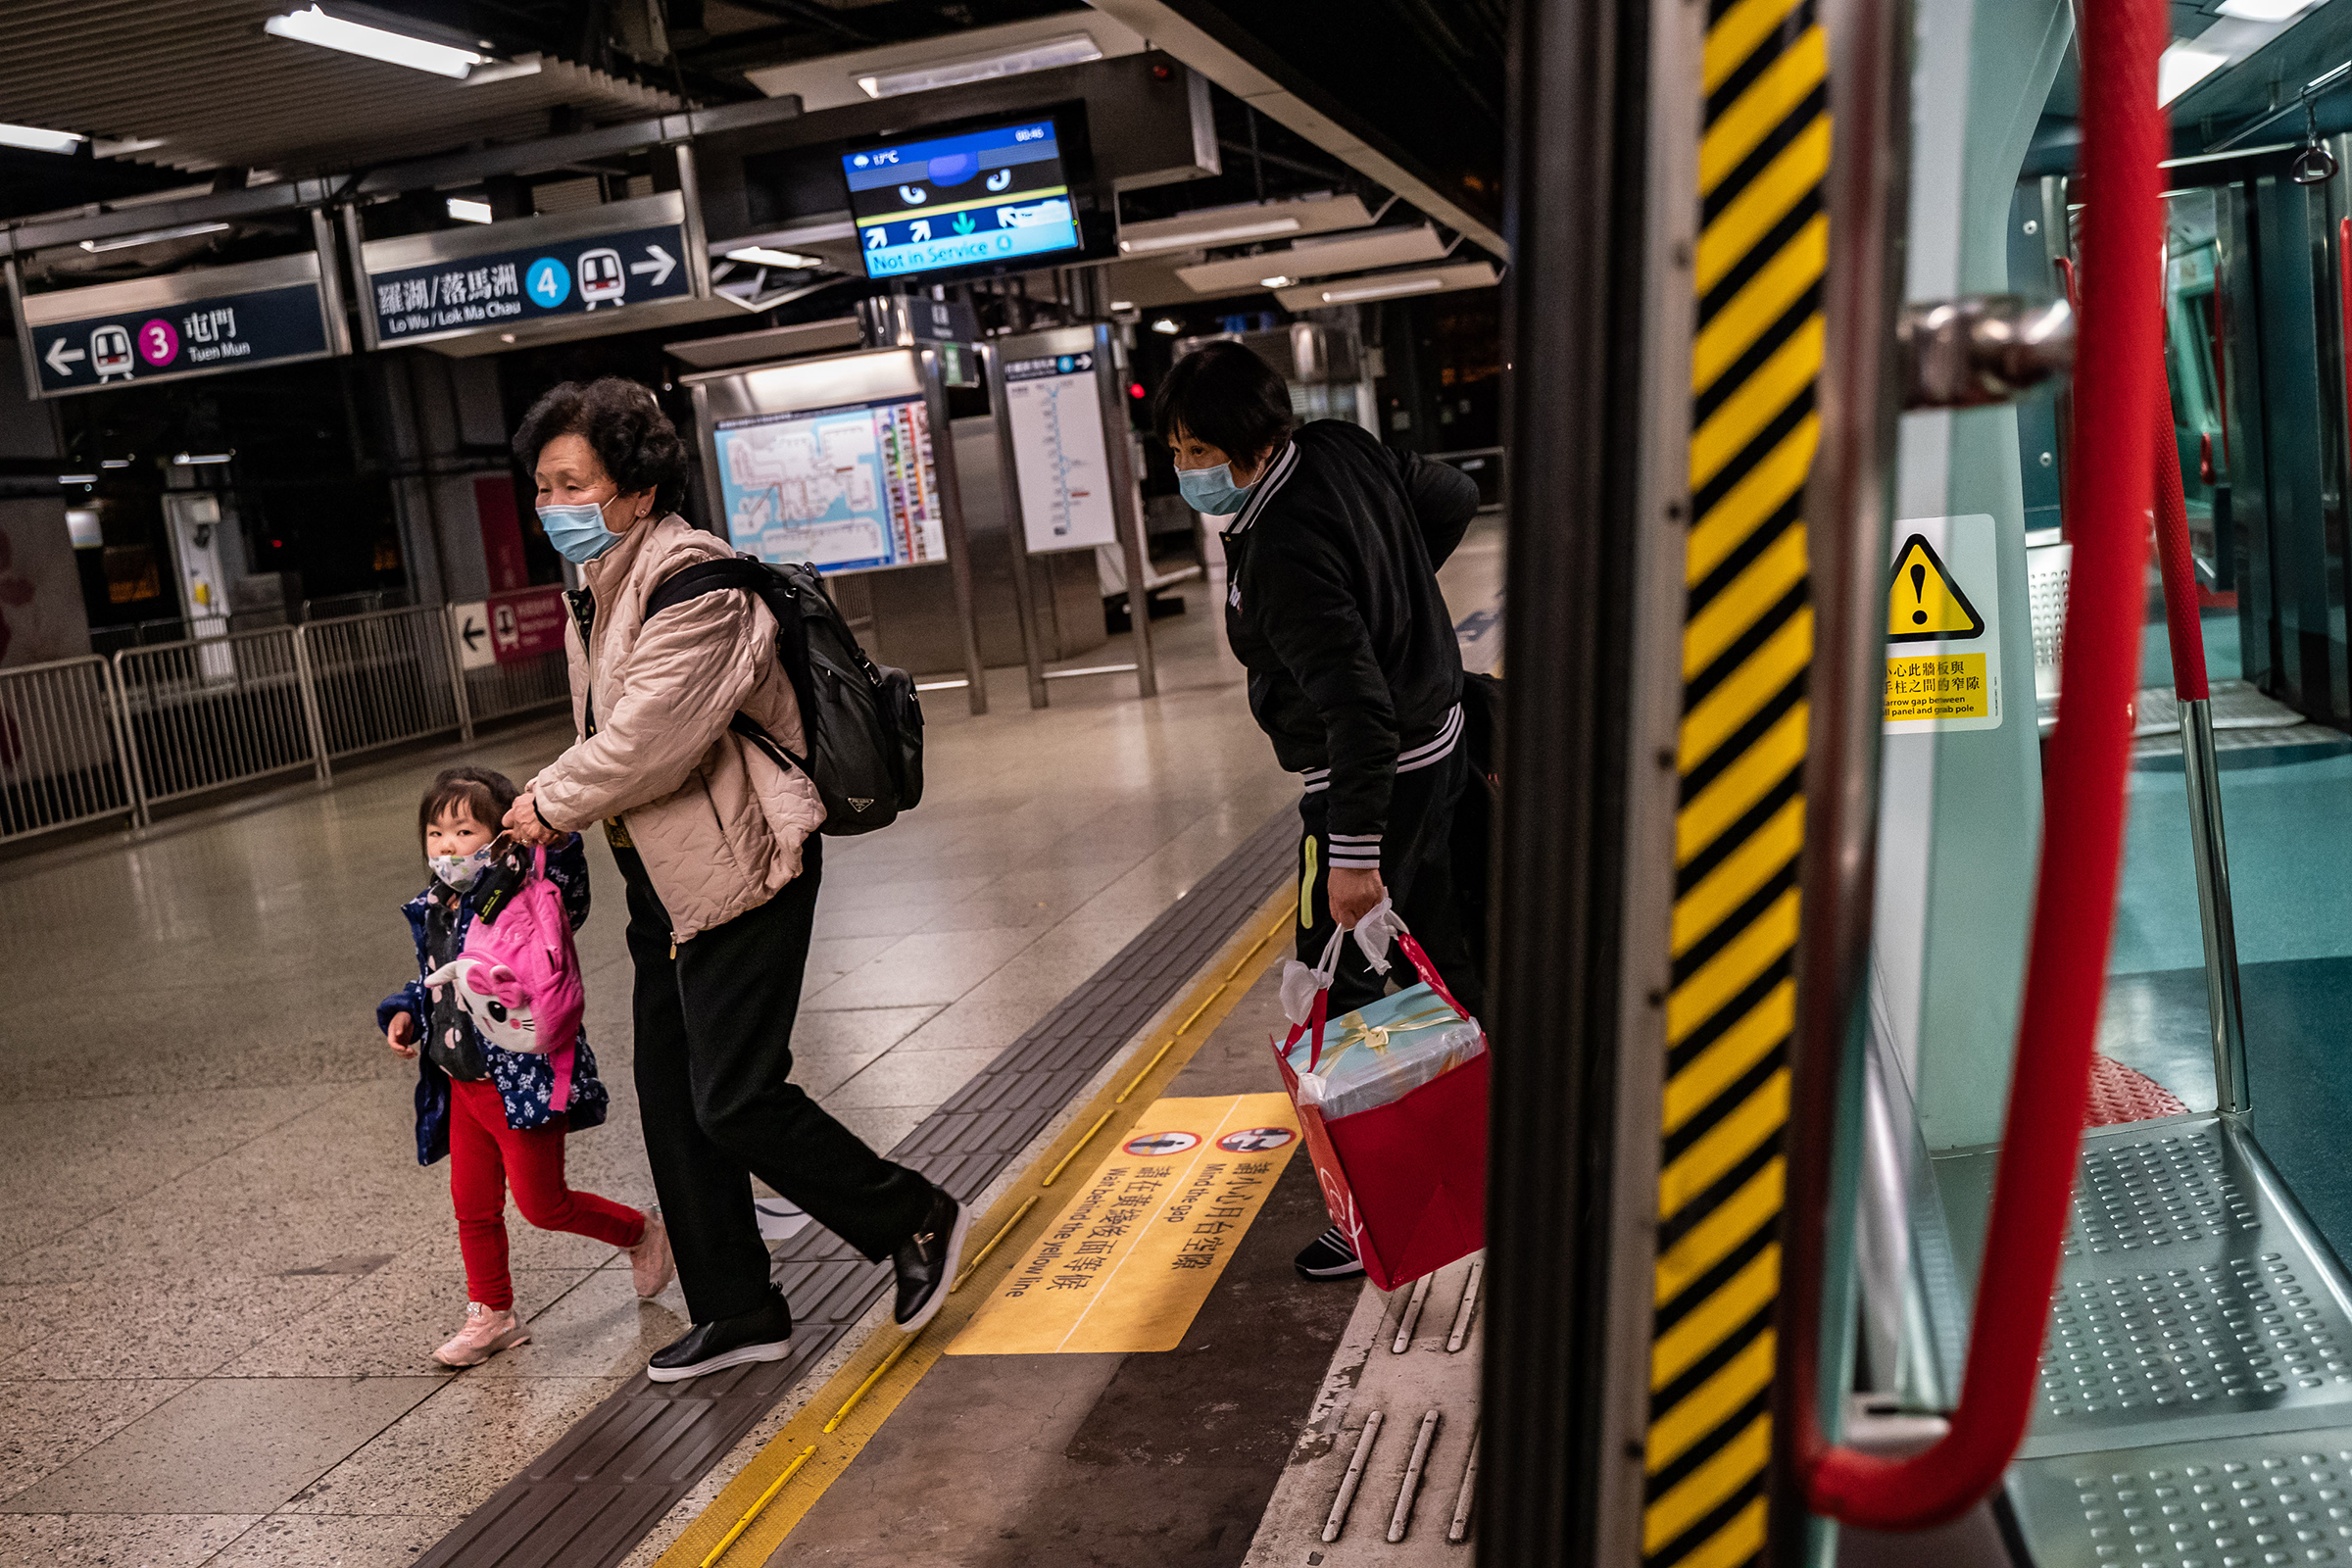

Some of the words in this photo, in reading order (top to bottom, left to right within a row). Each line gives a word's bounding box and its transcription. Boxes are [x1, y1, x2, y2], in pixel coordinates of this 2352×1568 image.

[873, 254, 904, 271] Not
[906, 250, 924, 265] in
[927, 241, 988, 264] Service
[537, 267, 558, 298] 4
[182, 307, 236, 343] 屯門
[388, 318, 407, 334] Lo
[406, 313, 429, 330] Wu
[438, 308, 464, 326] Lok
[464, 304, 486, 321] Ma
[485, 300, 521, 318] Chau
[149, 326, 170, 359] 3
[187, 346, 220, 363] Tuen
[220, 341, 251, 358] Mun
[1891, 707, 1916, 717] panel
[1916, 706, 1933, 714] and
[1934, 705, 1954, 715] grab
[1955, 704, 1975, 714] pole
[1911, 698, 1928, 707] gap
[1097, 1166, 1132, 1188] Wait
[1194, 1163, 1228, 1187] Mind
[1069, 1189, 1115, 1221] behind
[1181, 1188, 1209, 1203] the
[1163, 1204, 1193, 1223] gap
[1171, 1161, 1273, 1270] 請小心月台空隙
[1053, 1222, 1085, 1240] the
[1024, 1241, 1066, 1275] yellow
[1004, 1276, 1044, 1298] line
